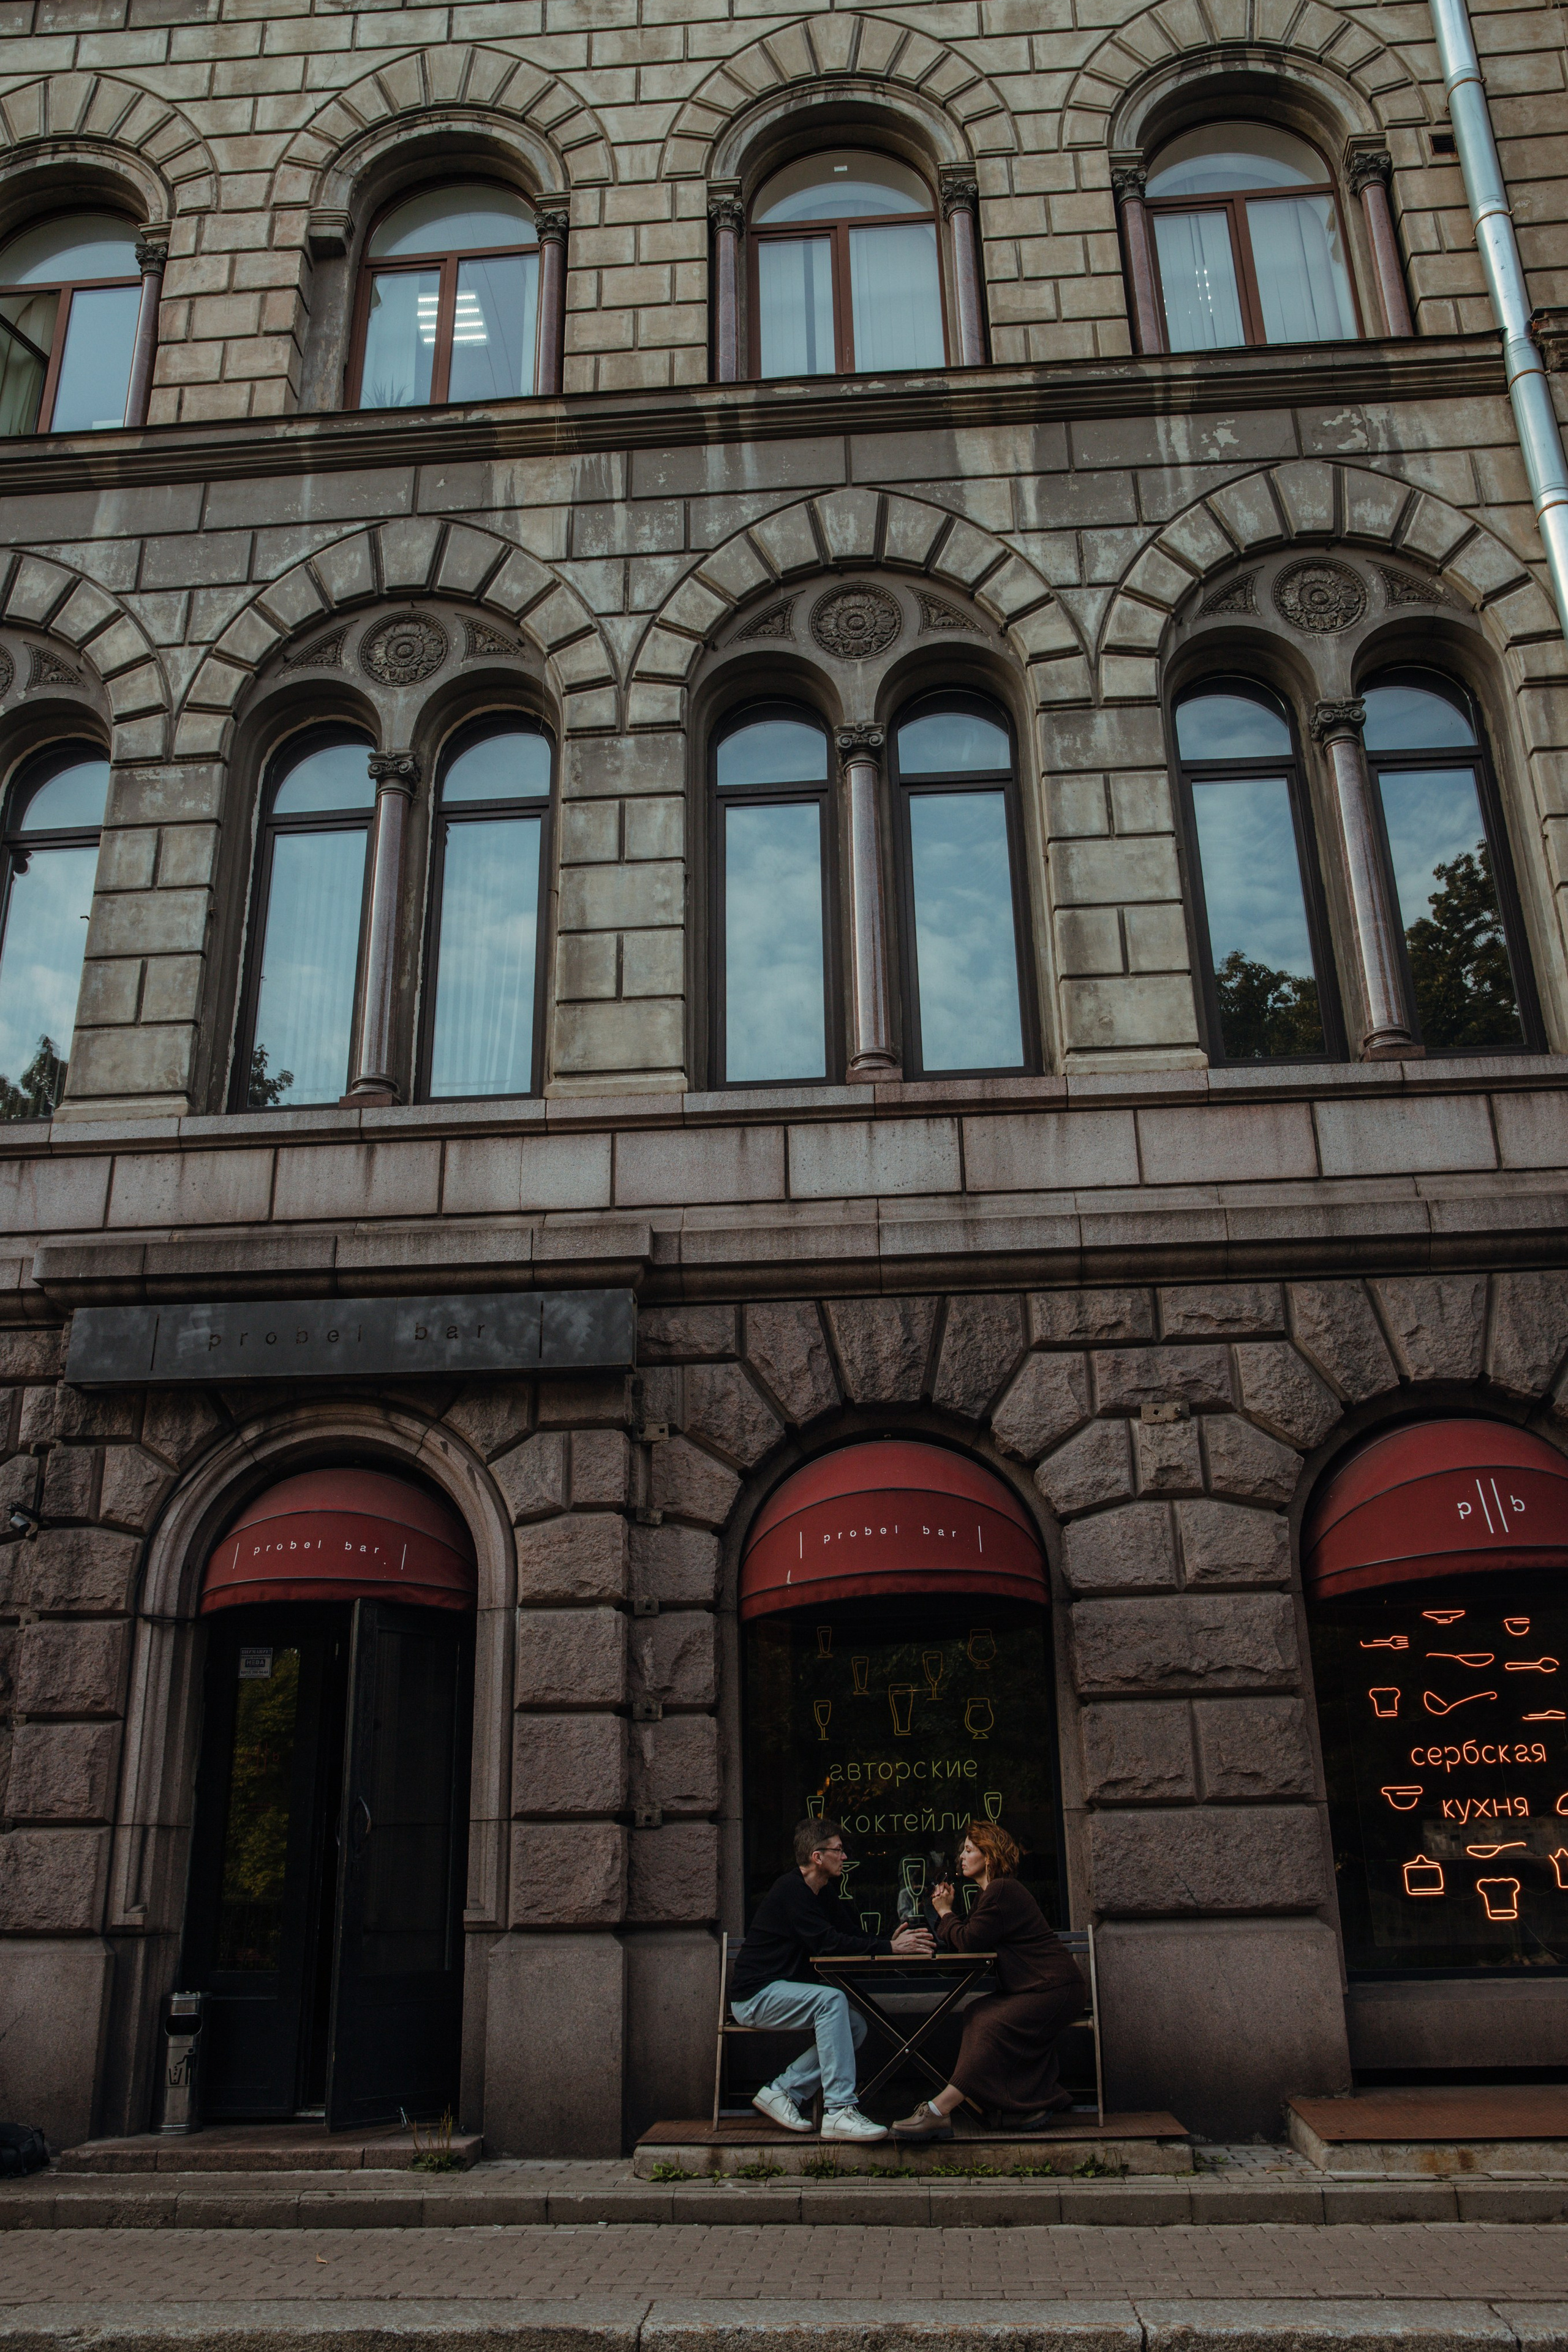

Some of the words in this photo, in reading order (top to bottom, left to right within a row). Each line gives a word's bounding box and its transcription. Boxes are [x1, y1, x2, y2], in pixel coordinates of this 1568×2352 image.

[208, 1325, 363, 1351] probel
[415, 1323, 485, 1340] bar
[253, 1540, 322, 1556] probel
[344, 1542, 379, 1554] bar
[824, 1525, 898, 1544] probel
[922, 1525, 956, 1537] bar
[1411, 1739, 1547, 1773] сербская
[829, 1759, 978, 1787] авторские
[840, 1807, 971, 1833] коктейли
[1442, 1796, 1529, 1825] кухня
